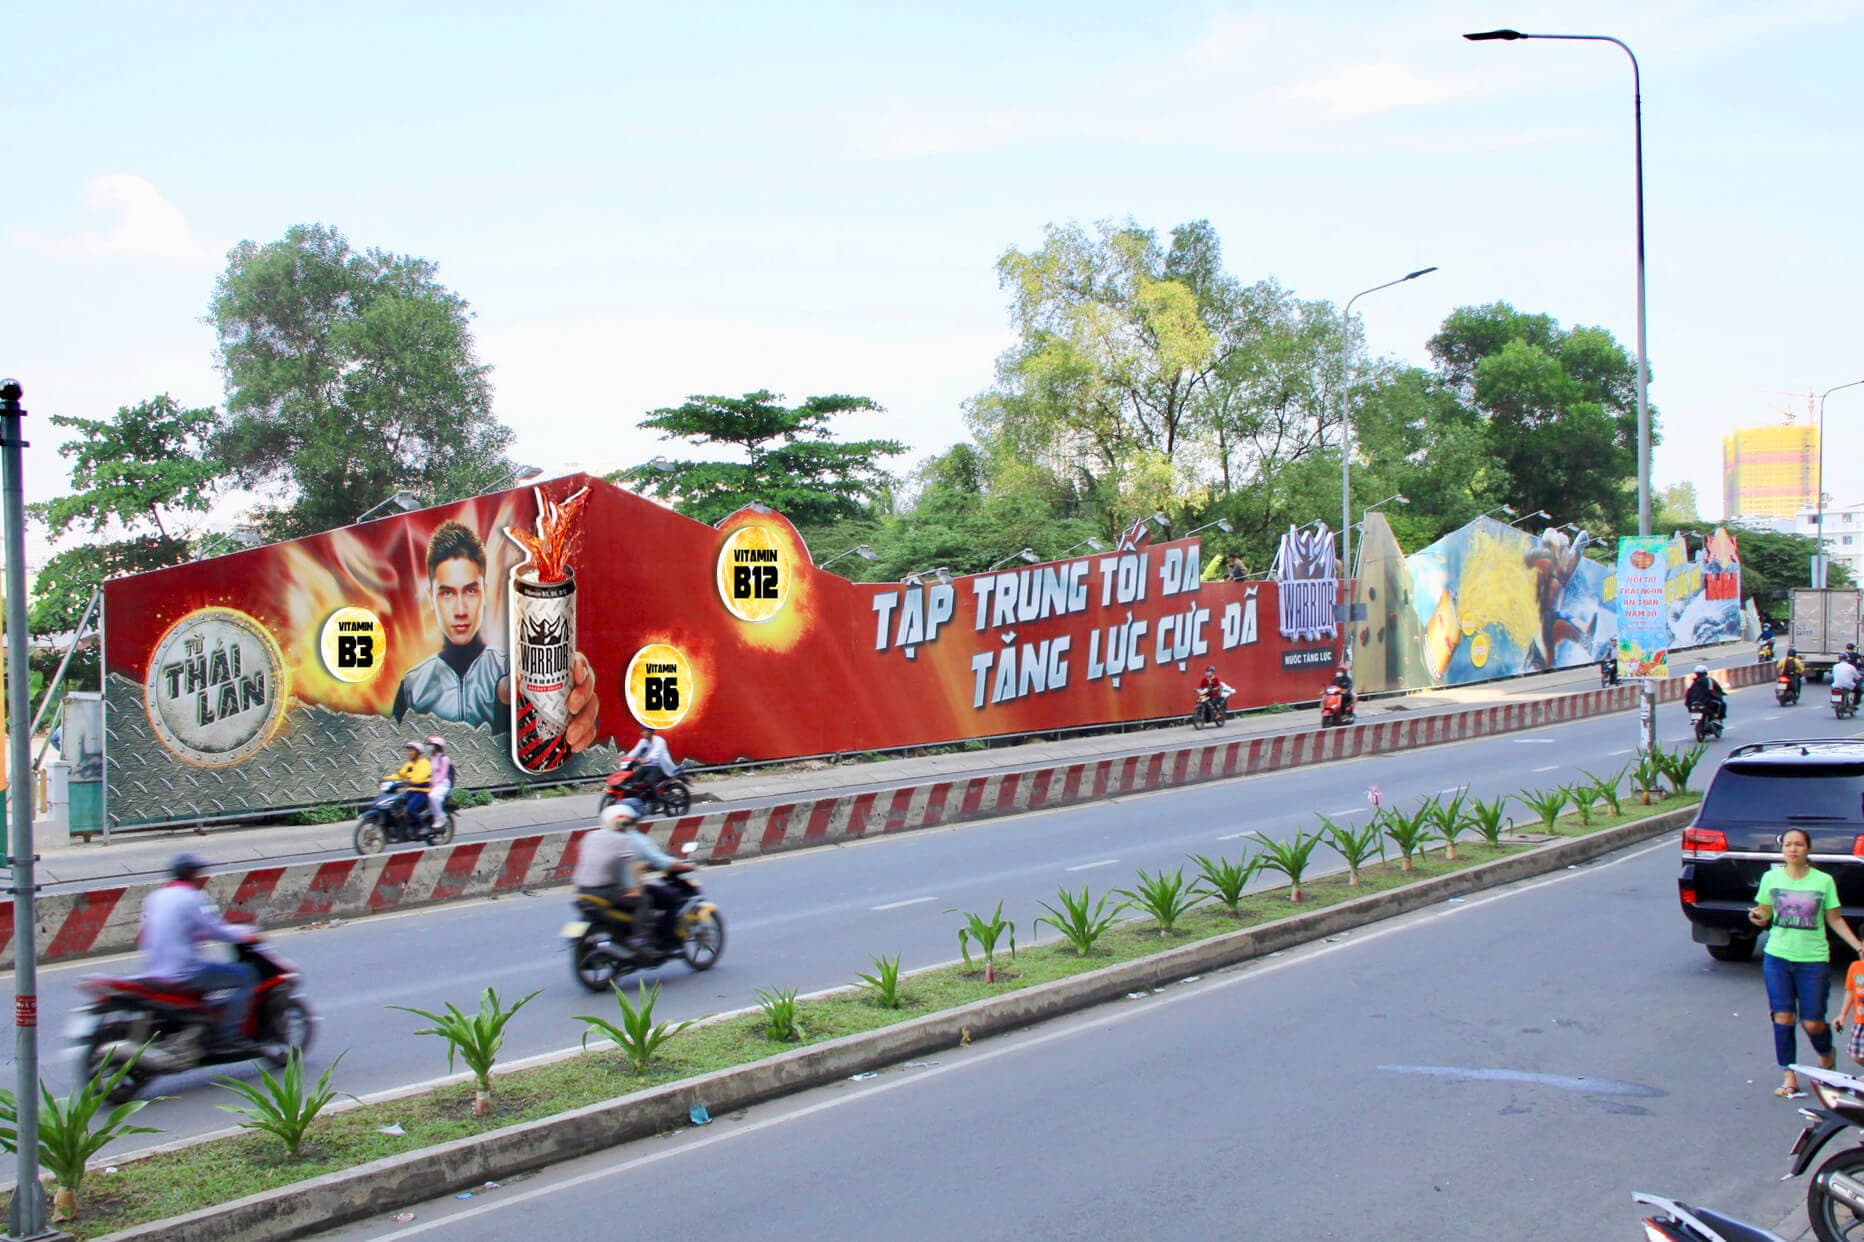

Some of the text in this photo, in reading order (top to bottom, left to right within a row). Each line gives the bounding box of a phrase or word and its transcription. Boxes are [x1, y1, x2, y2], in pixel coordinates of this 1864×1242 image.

[734, 549, 778, 562] VITAMIN
[734, 566, 778, 599] B12
[872, 525, 1200, 659] TẬP TRUNG TỐI ĐA
[1282, 582, 1335, 633] WARRIOR
[338, 621, 374, 632] VITAMIN
[338, 635, 374, 668] B3
[520, 644, 569, 677] WARRIOR
[971, 585, 1258, 708] TĂNG LỰC CỰC ĐÃ
[164, 638, 242, 700] THÁI
[197, 670, 266, 727] LAN
[645, 677, 680, 711] B6
